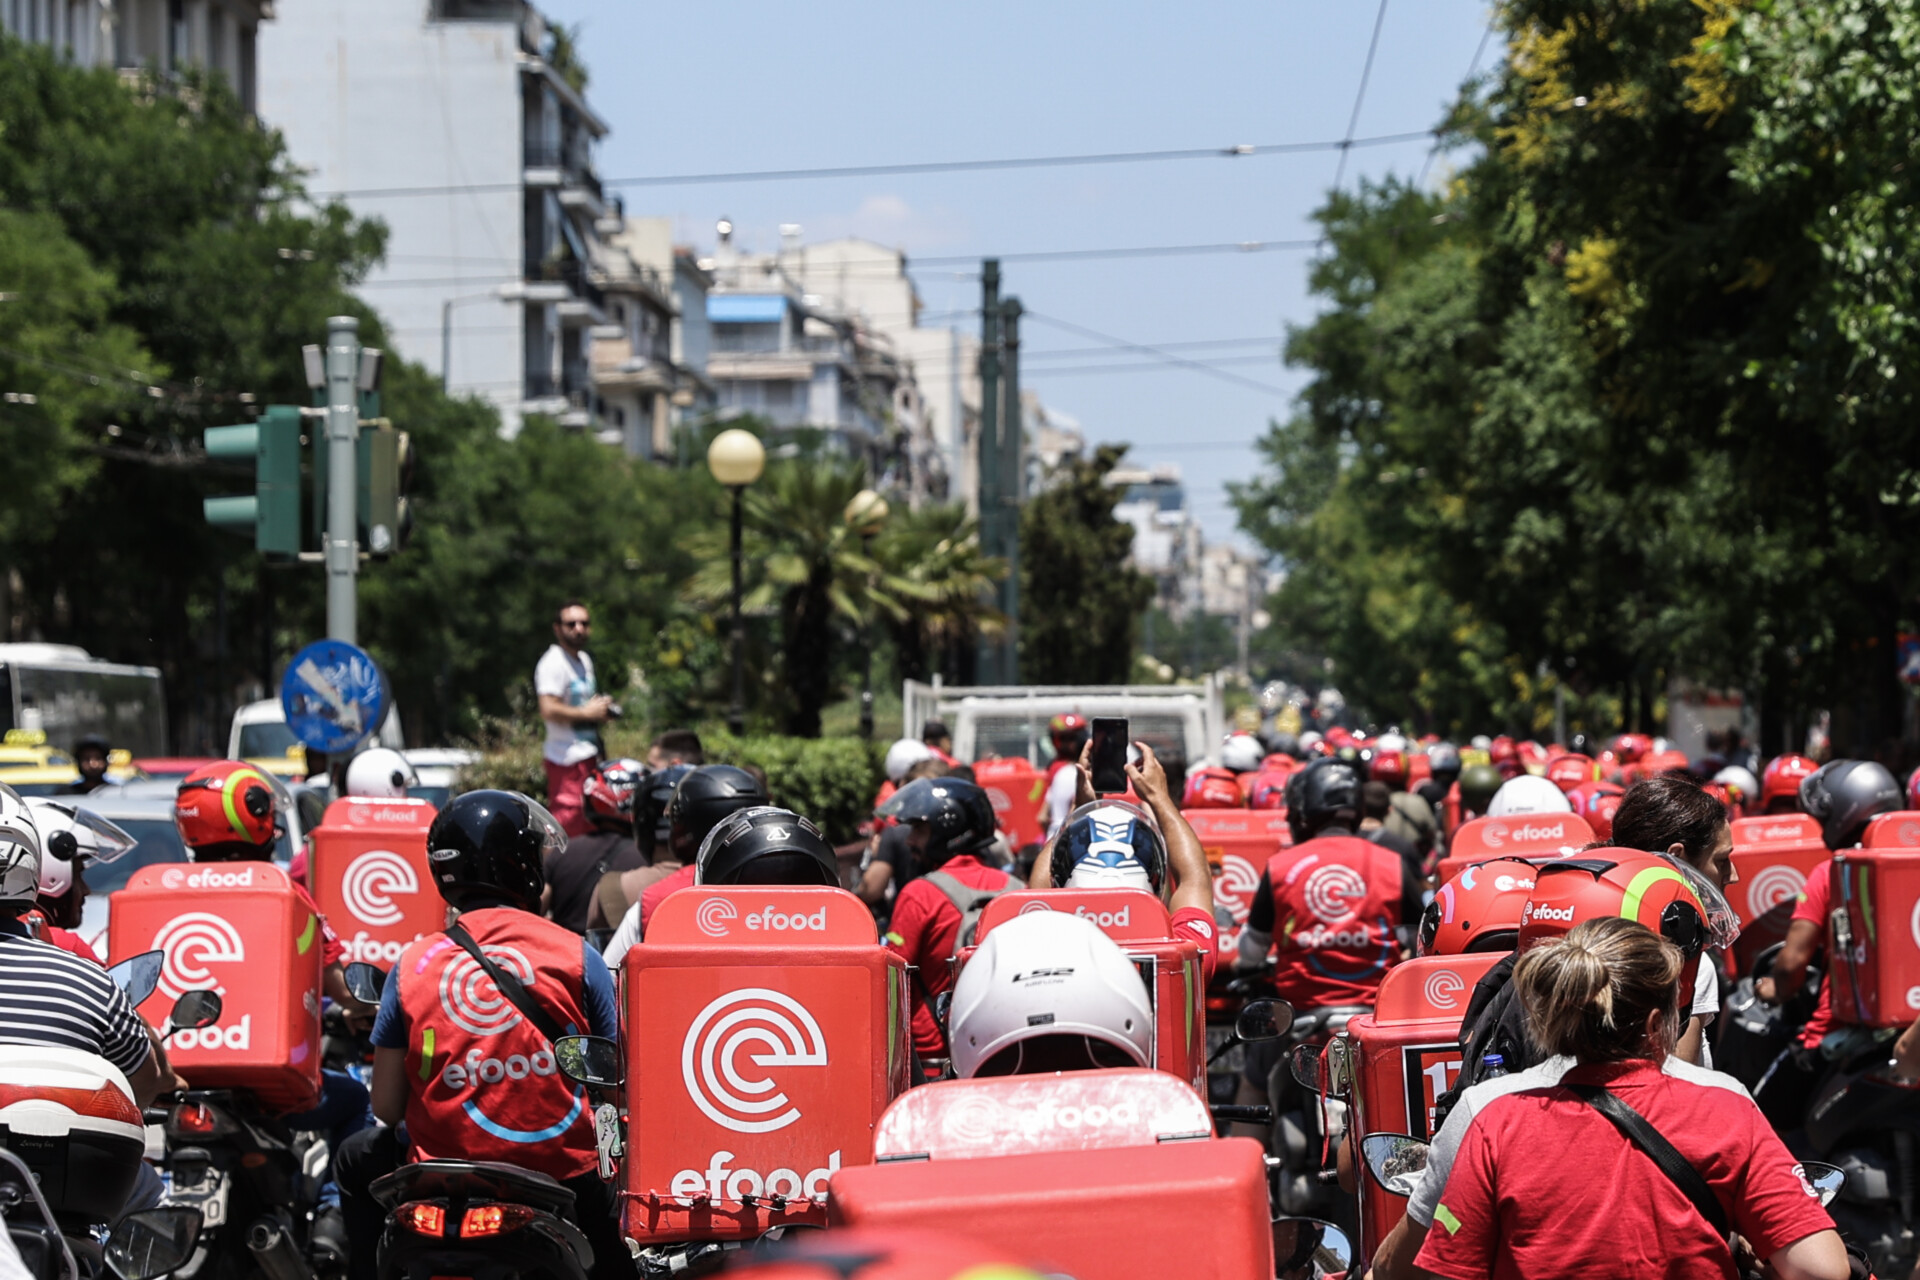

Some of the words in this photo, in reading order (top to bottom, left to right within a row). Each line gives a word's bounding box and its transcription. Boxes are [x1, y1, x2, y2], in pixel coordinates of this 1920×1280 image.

[1512, 823, 1564, 842] efood
[187, 867, 253, 888] efood
[745, 905, 827, 932] efood
[1074, 904, 1130, 928] food
[1532, 903, 1576, 922] efood
[1296, 924, 1370, 949] efood
[441, 1041, 557, 1089] efood
[1017, 1097, 1140, 1132] efood
[670, 1150, 842, 1208] efood
